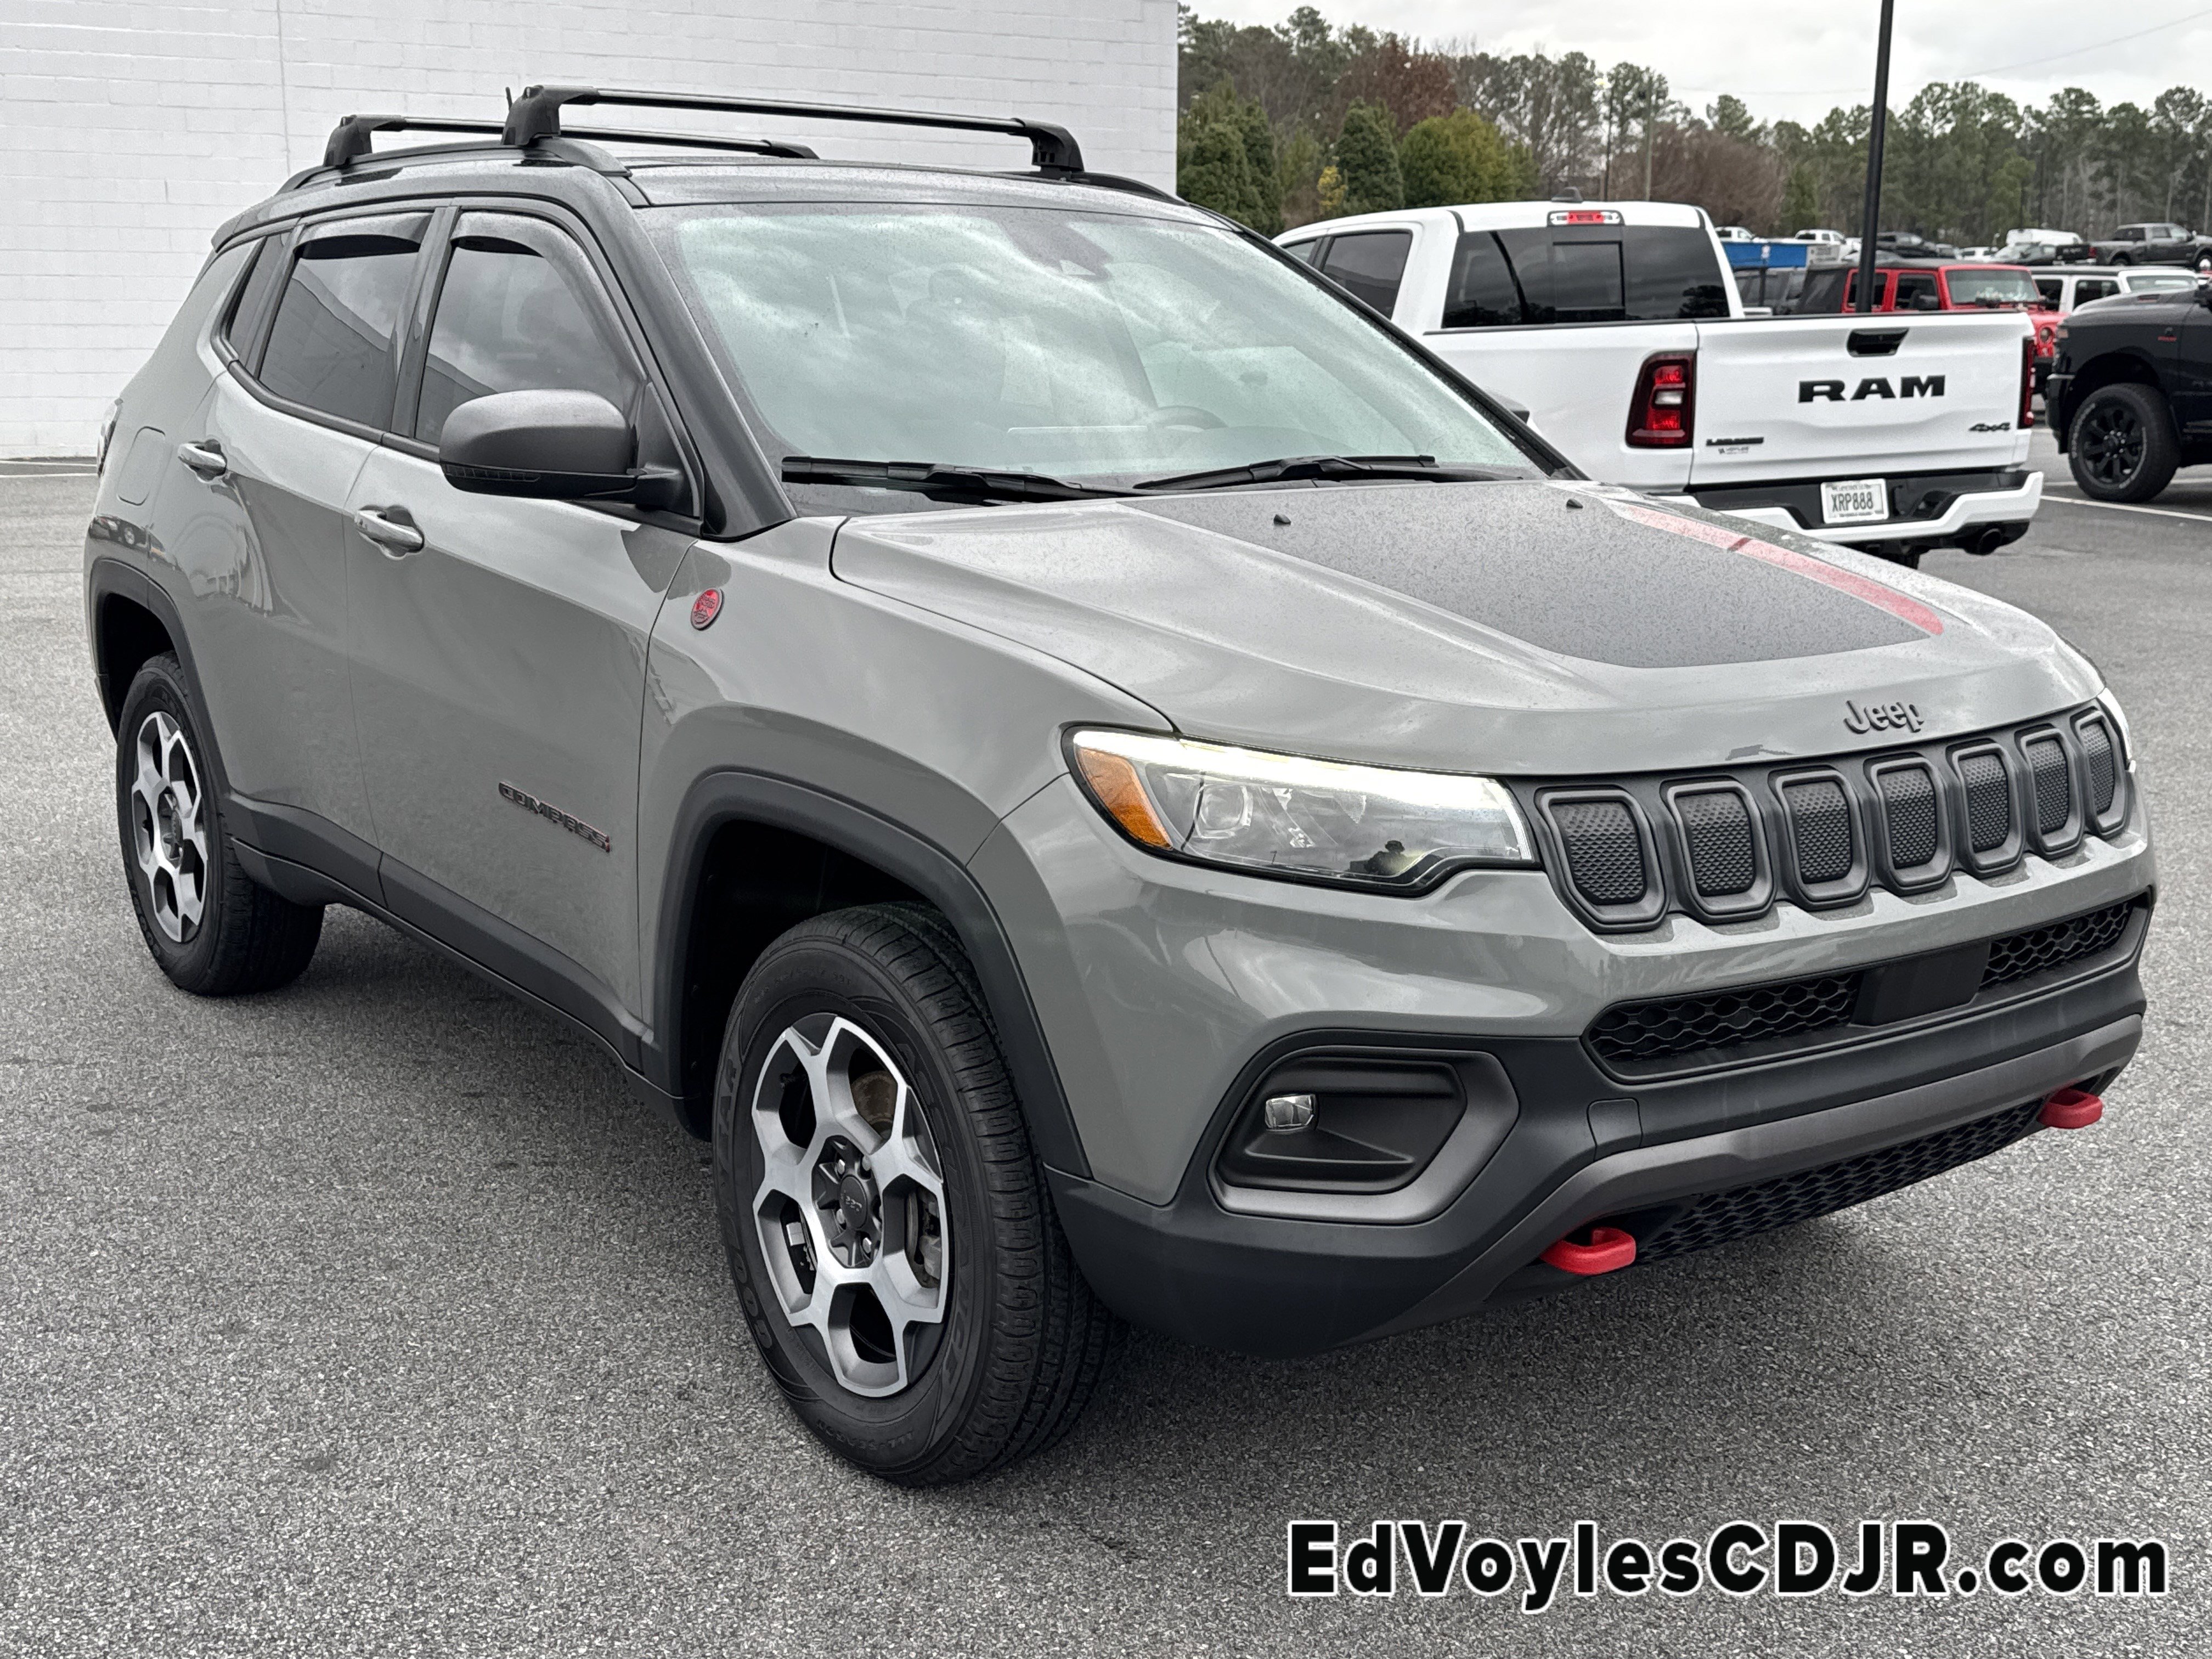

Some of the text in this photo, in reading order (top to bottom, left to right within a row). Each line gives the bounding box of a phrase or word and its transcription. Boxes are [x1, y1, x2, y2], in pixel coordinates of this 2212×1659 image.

[1798, 375, 1945, 403] RAM
[1968, 422, 2010, 432] 4x4
[1831, 492, 1874, 512] XRP888
[1843, 700, 1925, 734] Jeep
[498, 781, 610, 853] COMPASS
